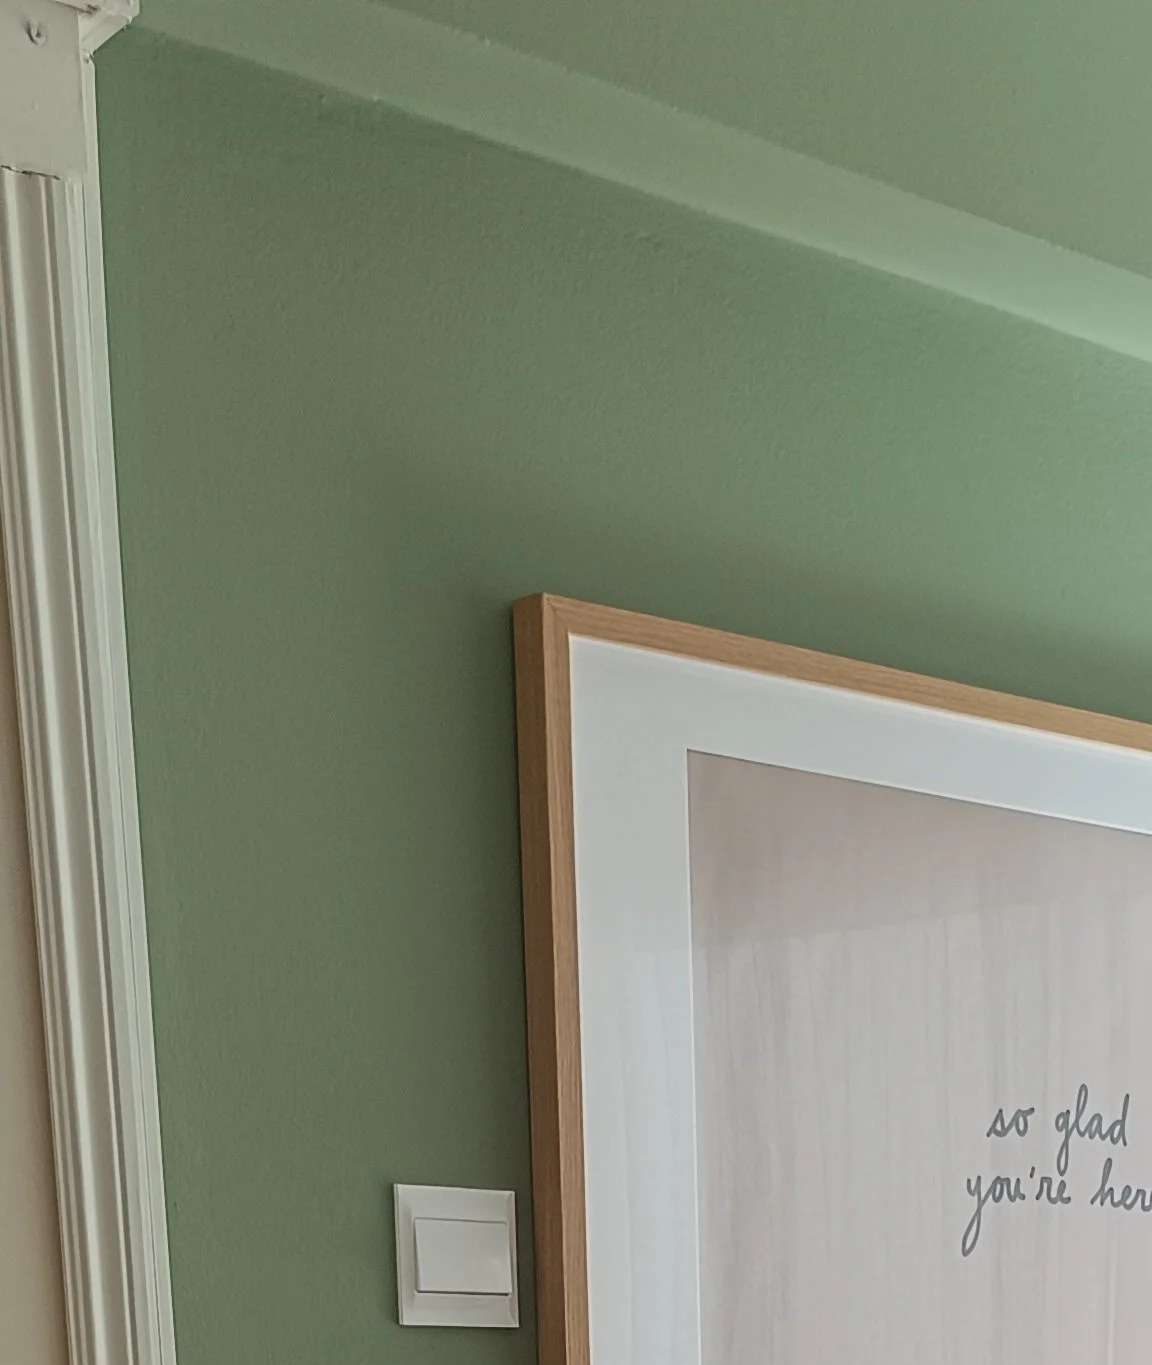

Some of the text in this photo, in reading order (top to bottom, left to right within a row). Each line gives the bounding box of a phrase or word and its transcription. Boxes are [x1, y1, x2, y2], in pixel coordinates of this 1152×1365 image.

[986, 1083, 1130, 1177] so glad
[961, 1166, 1072, 1258] you're
